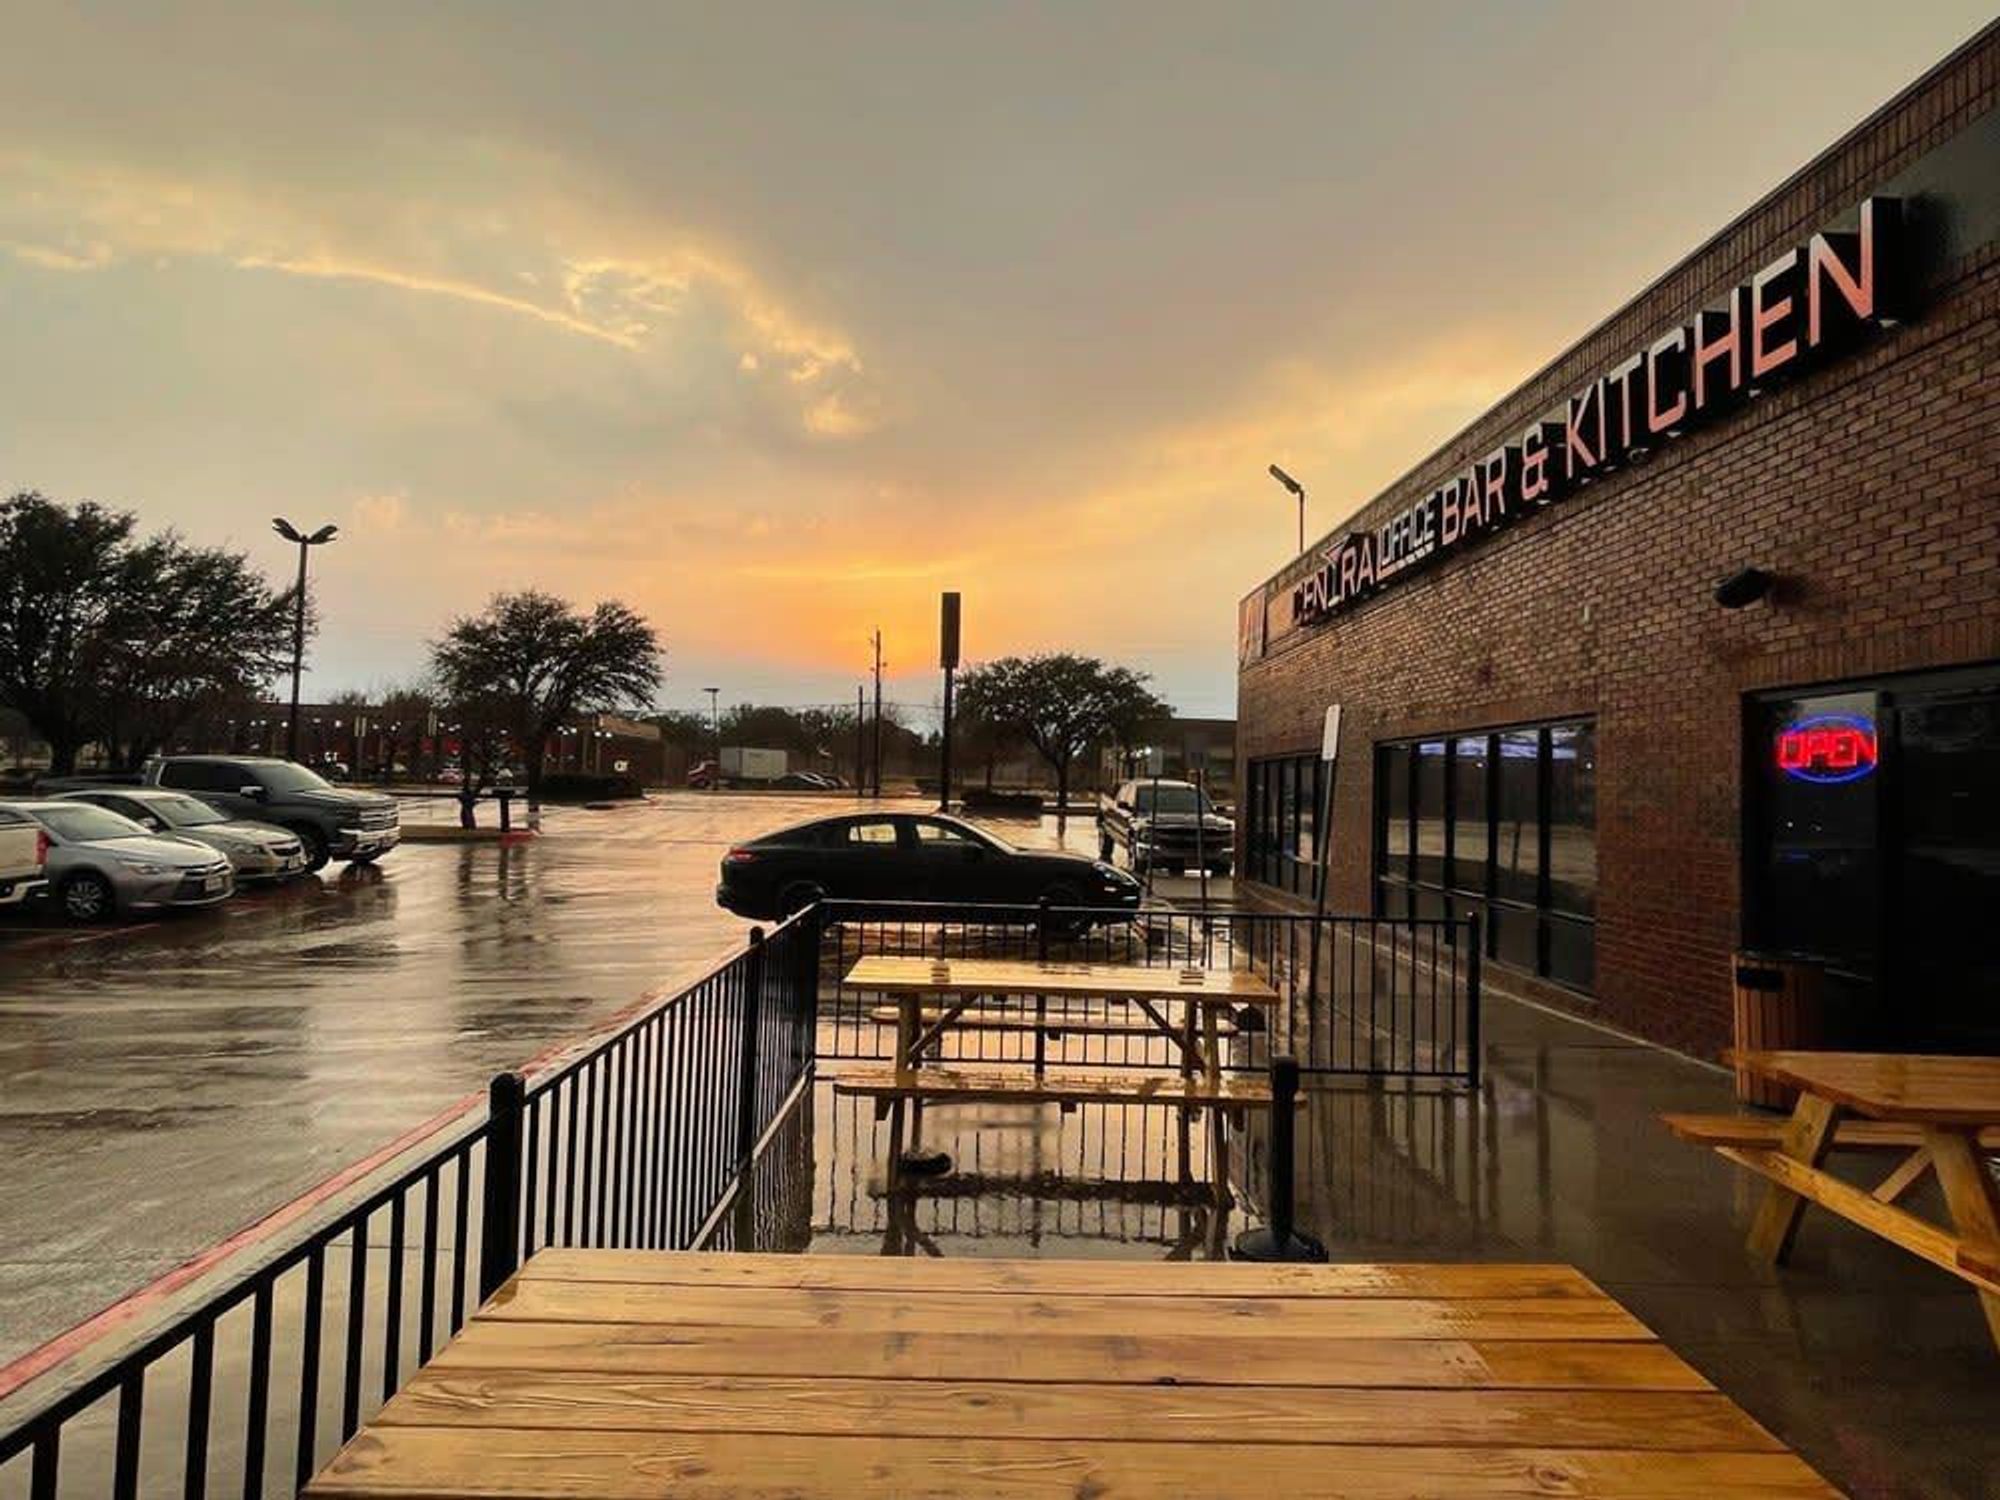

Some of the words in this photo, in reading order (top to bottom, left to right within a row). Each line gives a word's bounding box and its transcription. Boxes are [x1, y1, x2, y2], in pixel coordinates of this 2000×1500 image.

[1442, 446, 1507, 546] BAR
[1522, 422, 1548, 500] &
[1566, 198, 1873, 480] KITCHEN
[1778, 727, 1877, 769] OPEN
